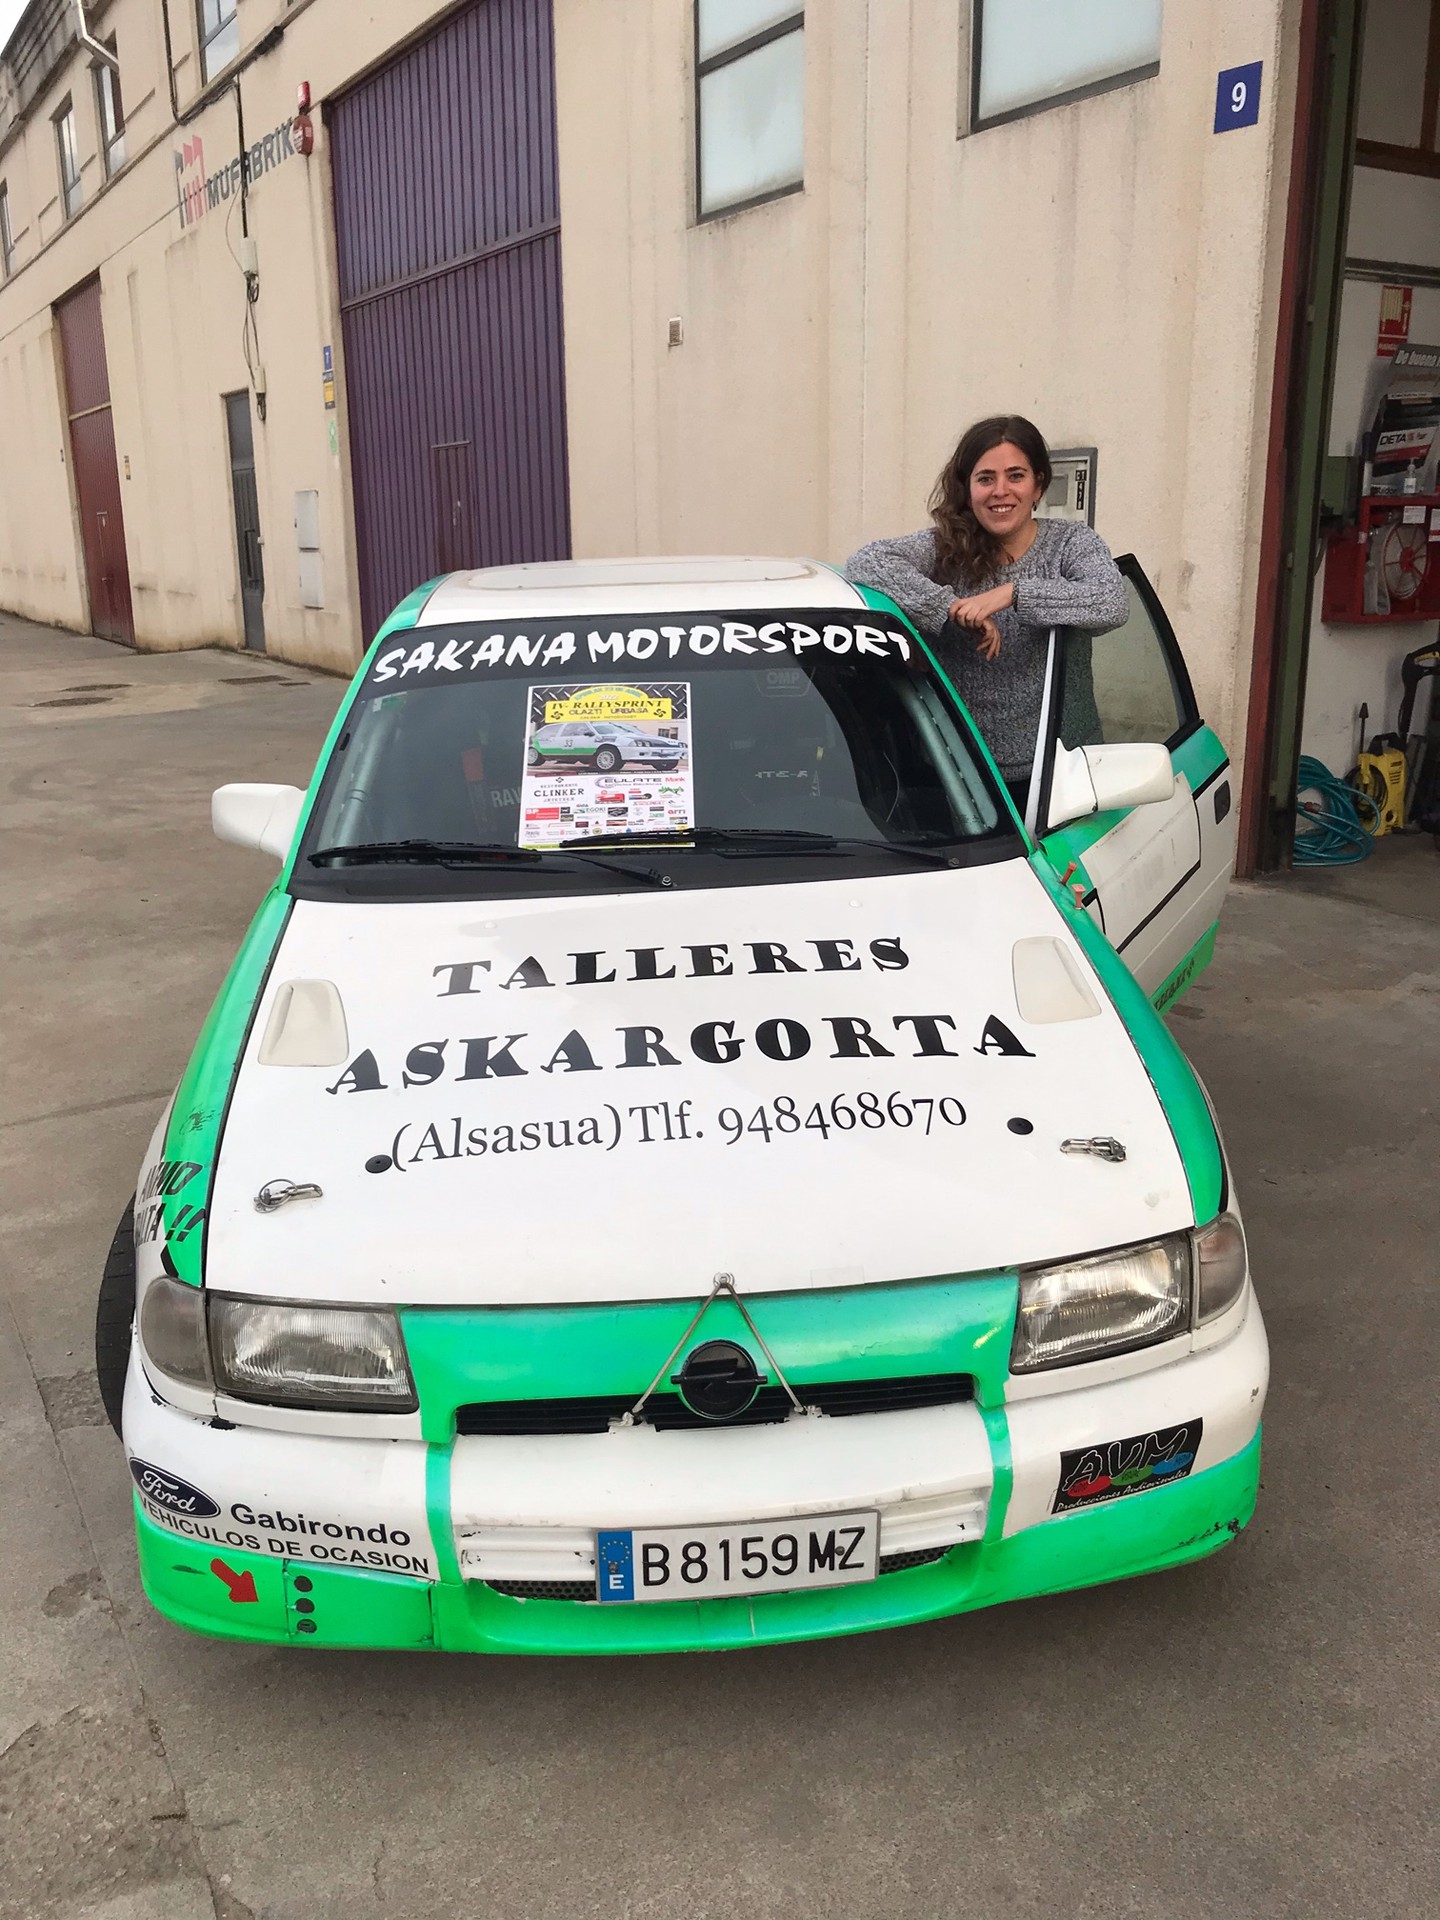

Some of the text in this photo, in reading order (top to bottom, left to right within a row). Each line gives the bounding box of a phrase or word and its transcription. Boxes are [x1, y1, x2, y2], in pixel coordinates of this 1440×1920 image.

[1231, 81, 1247, 113] 9
[1380, 432, 1406, 446] DETA
[373, 621, 911, 683] SAKANA MOTORSPORT
[766, 671, 800, 685] OMP
[573, 700, 664, 709] RALLYSPRINT
[533, 788, 585, 797] CLINKER
[432, 936, 911, 998] TALLERES
[325, 1013, 1037, 1096] ASKARGORTA
[391, 1090, 967, 1172] (Alsasua) Tlf. 948468670
[1061, 1427, 1188, 1491] AVM
[140, 1469, 197, 1513] Ford
[1056, 1491, 1121, 1512] Producciones
[1123, 1470, 1187, 1495] Audiovisuales
[139, 1496, 430, 1574] VEHICULOS DE OCASION
[230, 1502, 412, 1547] Gabirondo
[609, 1526, 866, 1590] E B8159MZ
